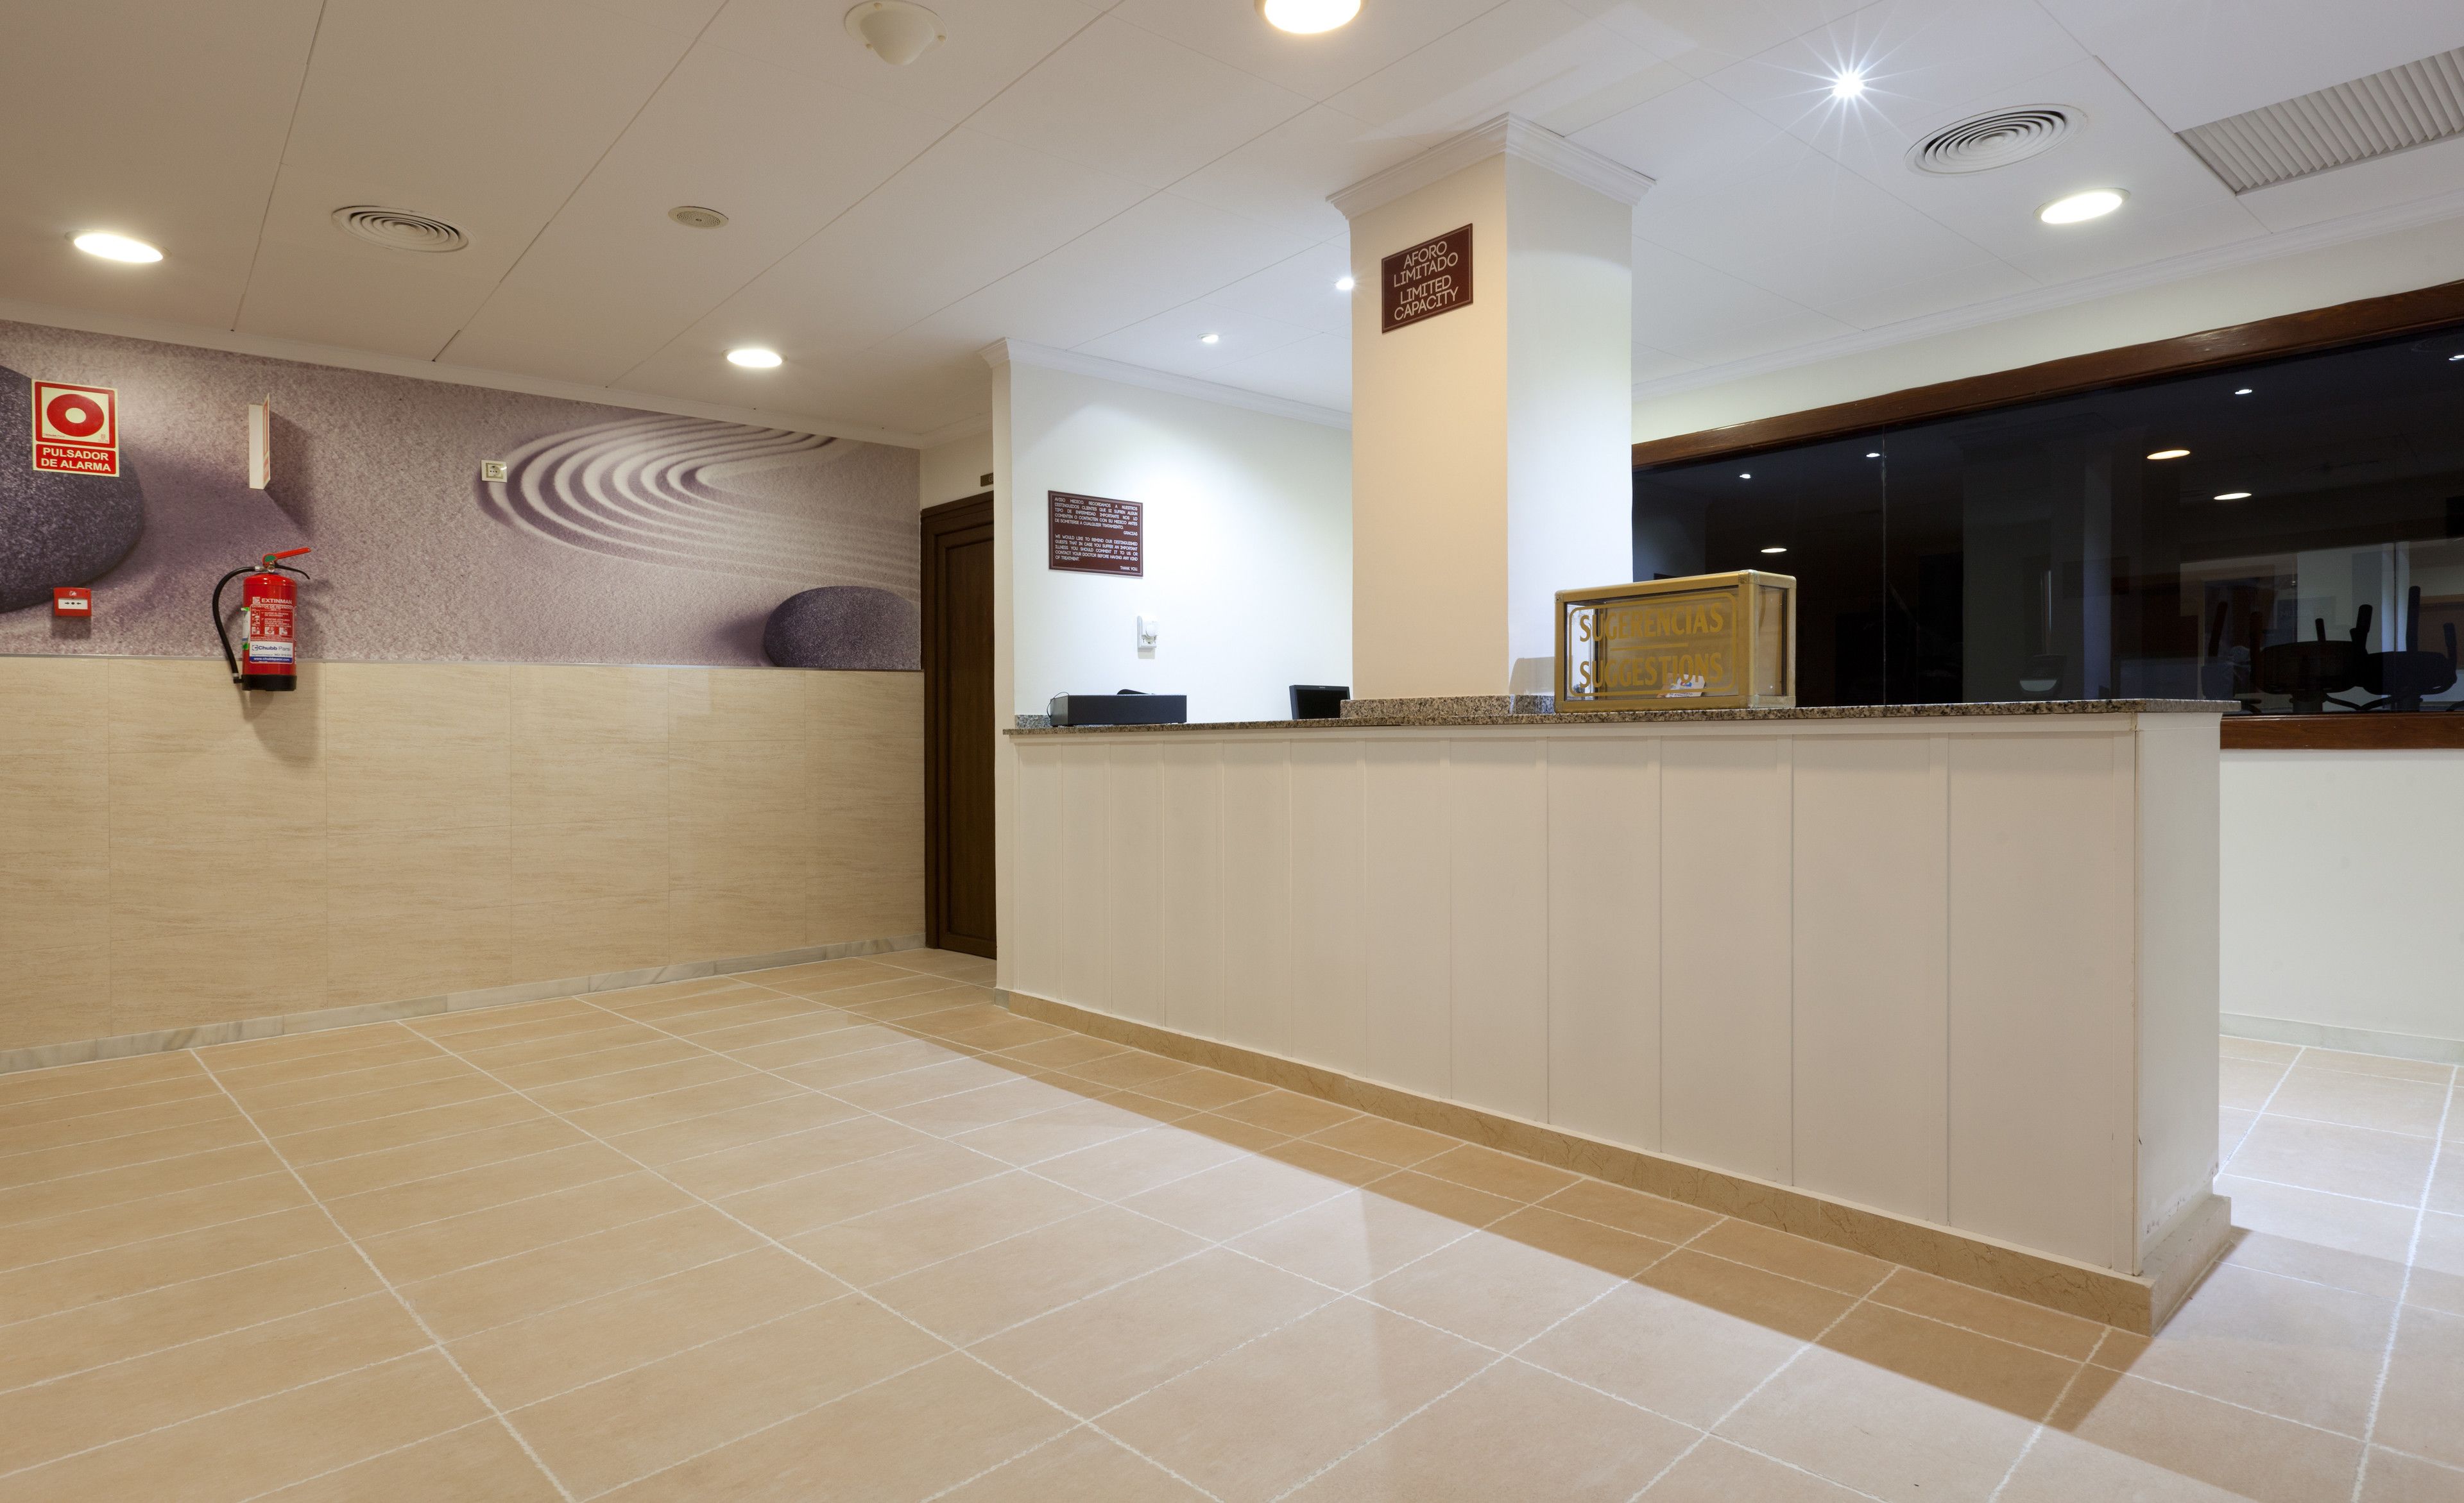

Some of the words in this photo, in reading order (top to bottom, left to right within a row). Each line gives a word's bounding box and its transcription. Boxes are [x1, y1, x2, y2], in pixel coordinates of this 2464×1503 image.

[1394, 252, 1459, 287] LIMITADO
[1403, 241, 1447, 269] AFORO
[1394, 286, 1459, 321] CAPACITY
[1400, 275, 1451, 305] LIMITED
[41, 458, 57, 467] DE
[60, 460, 111, 471] ALARMA
[42, 447, 109, 461] PULSADOR
[1580, 602, 1724, 642] SUGERENCIAS
[1580, 652, 1724, 688] SUGGESTIONS
